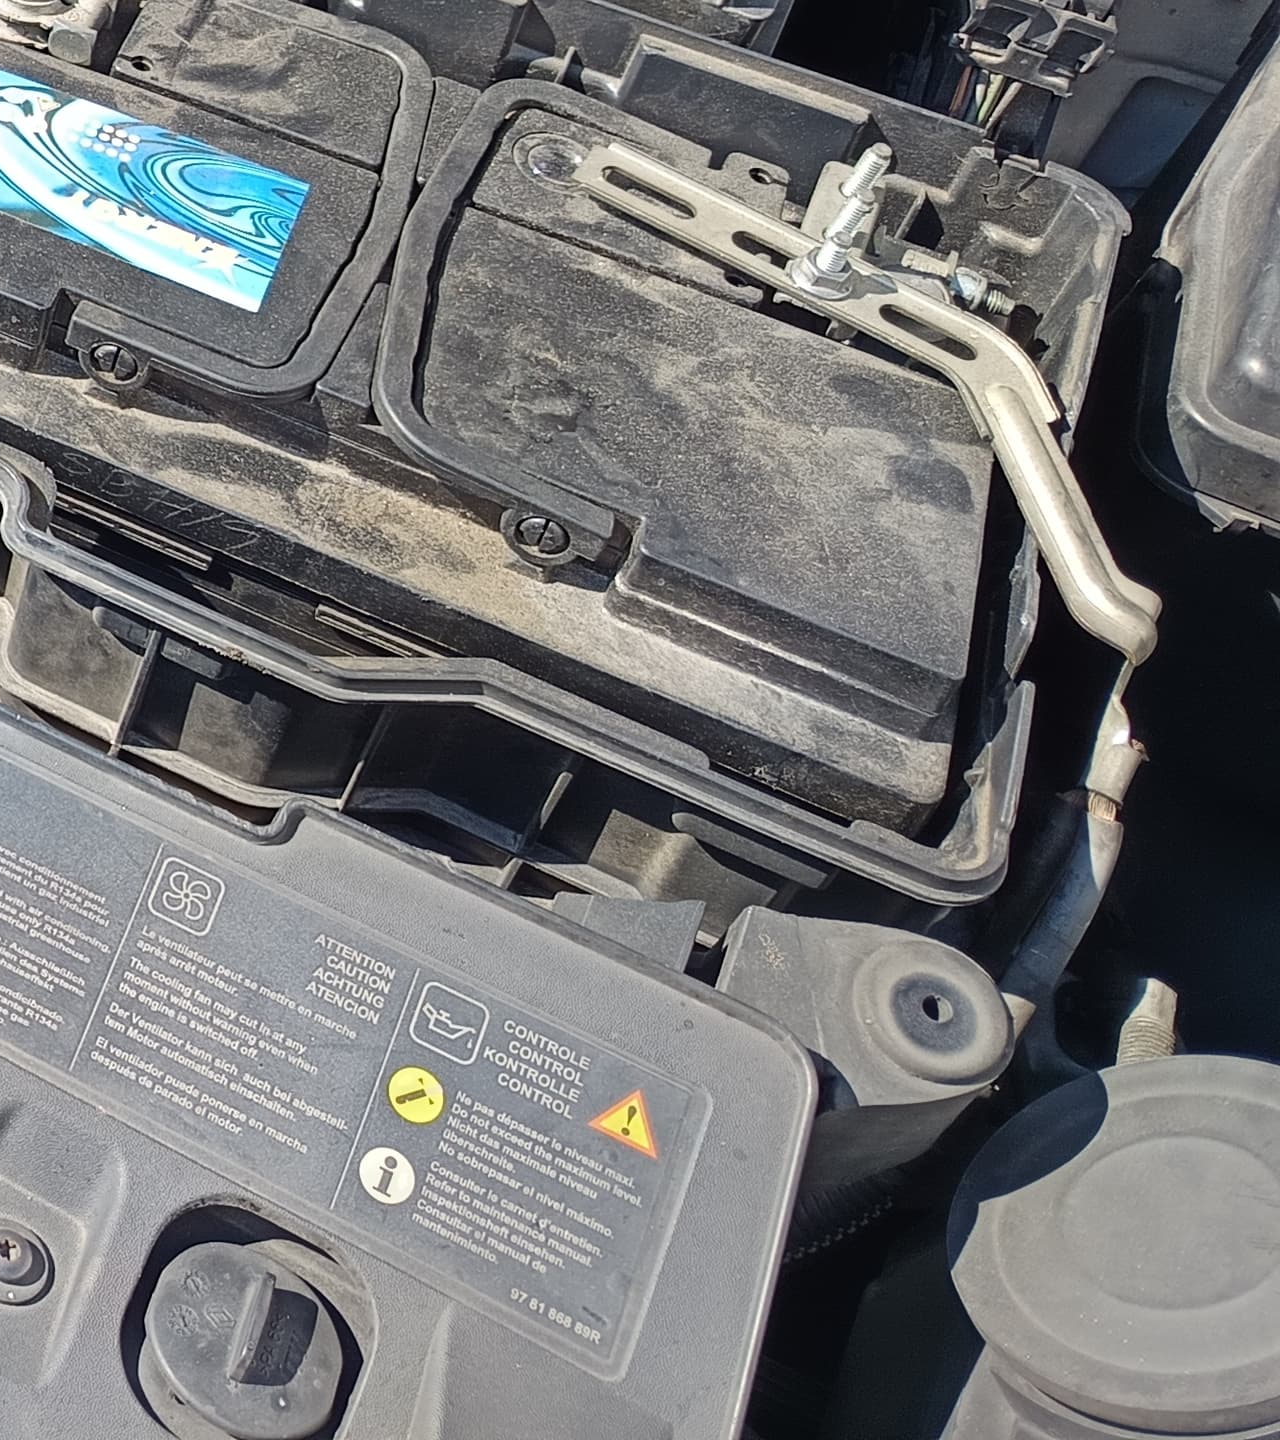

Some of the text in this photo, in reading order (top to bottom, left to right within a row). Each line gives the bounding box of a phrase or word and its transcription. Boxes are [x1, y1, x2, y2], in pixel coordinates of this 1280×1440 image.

[156, 934, 216, 970] ventilateur
[214, 964, 244, 983] peut
[258, 985, 296, 1010] mettre
[312, 1012, 357, 1040] marche
[312, 964, 385, 1009] ACHTUNG
[313, 931, 396, 980] ATTENTION
[324, 953, 391, 994] CAUTION
[117, 980, 137, 998] the
[137, 992, 176, 1018] engine
[188, 1018, 240, 1050] switched
[122, 970, 318, 1076] moment without warning even when
[127, 956, 150, 975] The
[149, 969, 193, 999] cooling
[192, 989, 212, 1007] fan
[212, 1001, 238, 1022] may
[237, 1013, 259, 1030] cut
[283, 1037, 307, 1057] any
[304, 978, 380, 1025] ATENCION
[103, 1013, 126, 1033] tem
[126, 1025, 160, 1050] Motor
[159, 1044, 229, 1086] automatisch
[108, 1001, 130, 1020] Der
[129, 1012, 184, 1048] Ventilator
[183, 1040, 213, 1063] kann
[213, 1057, 239, 1076] sich
[241, 1072, 272, 1093] auch
[271, 1085, 292, 1103] bei
[482, 1045, 581, 1102] KONTROLLE
[502, 1018, 591, 1070] CONTROLE
[507, 1039, 586, 1086] CONTROL
[89, 1047, 138, 1081] después
[152, 1083, 194, 1110] parado
[107, 1044, 164, 1079] ventilador
[162, 1073, 200, 1098] puede
[199, 1092, 247, 1123] ponerse
[263, 1125, 308, 1155] marcha
[496, 1071, 575, 1119] CONTROL
[446, 1114, 598, 1200] Nicht das maximale niveau
[468, 1113, 491, 1130] not
[489, 1124, 533, 1152] exceed
[532, 1143, 553, 1162] the
[553, 1156, 611, 1192] maximum
[471, 1100, 495, 1118] pas
[495, 1110, 550, 1145] dépasser
[563, 1145, 603, 1172] niveau
[420, 1184, 509, 1239] Inspektionsheft
[424, 1171, 457, 1197] Refer
[471, 1198, 546, 1244] maintenance
[428, 1159, 486, 1197] Consulter
[499, 1197, 538, 1224] carnet
[455, 1151, 522, 1191] sobrepasar
[534, 1191, 565, 1213] nivel
[415, 1197, 473, 1235] Consultar
[485, 1235, 531, 1266] manual
